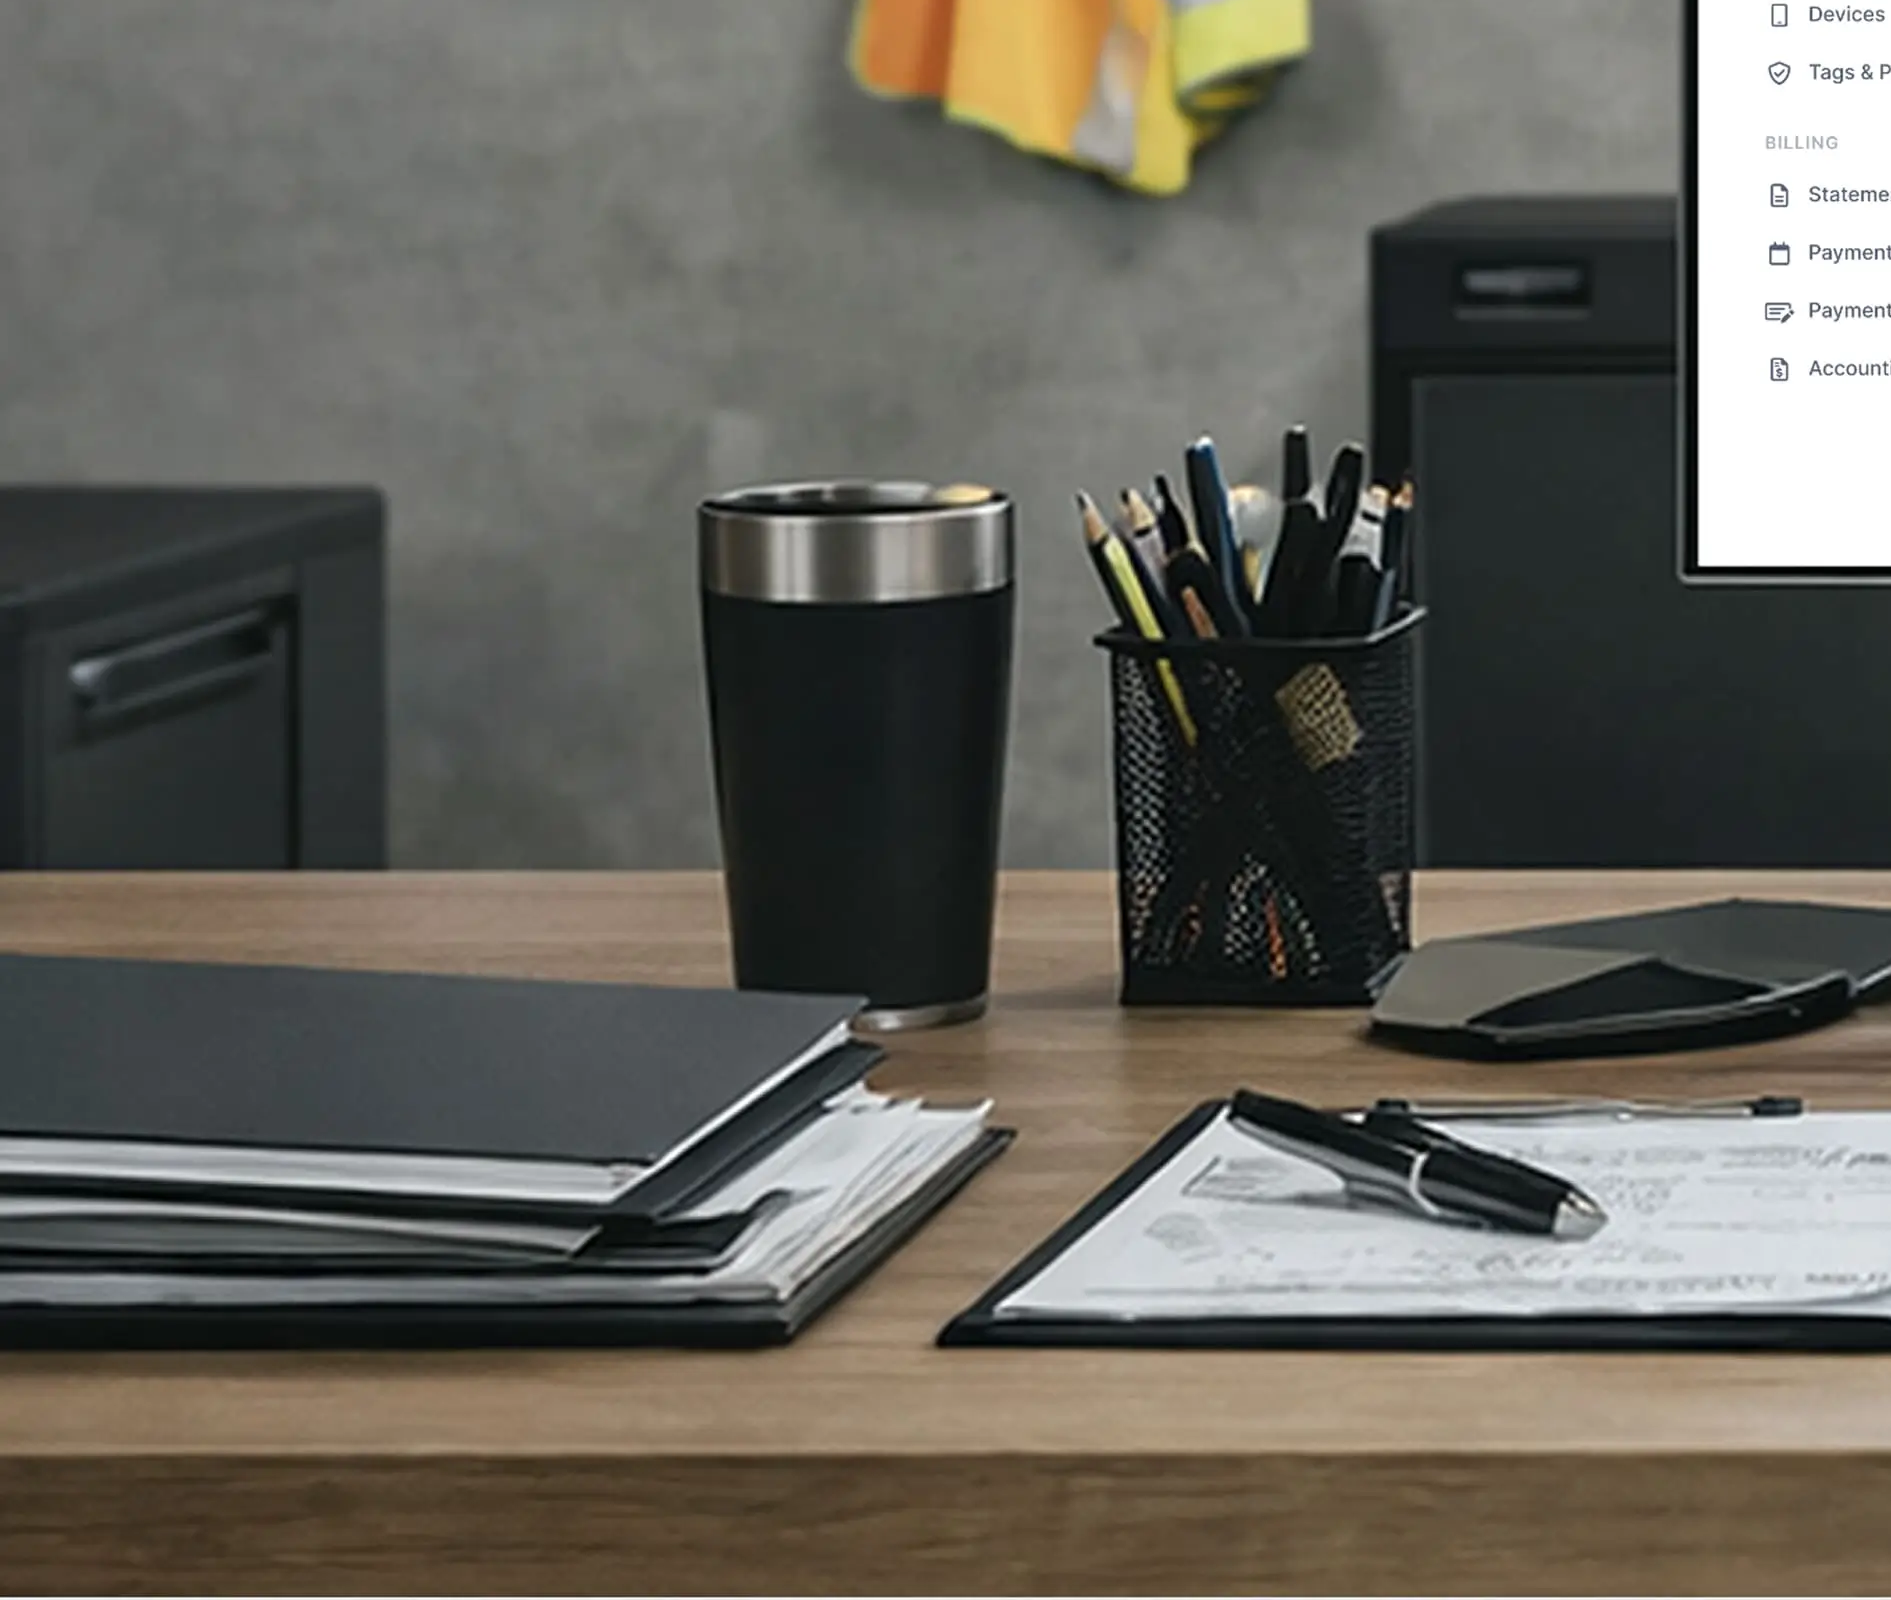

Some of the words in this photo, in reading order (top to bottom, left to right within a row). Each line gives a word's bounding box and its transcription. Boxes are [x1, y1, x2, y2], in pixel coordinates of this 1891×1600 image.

[1808, 4, 1886, 23] Devices
[1808, 63, 1856, 85] Tags
[1860, 63, 1874, 81] &
[1765, 135, 1838, 150] BILLING
